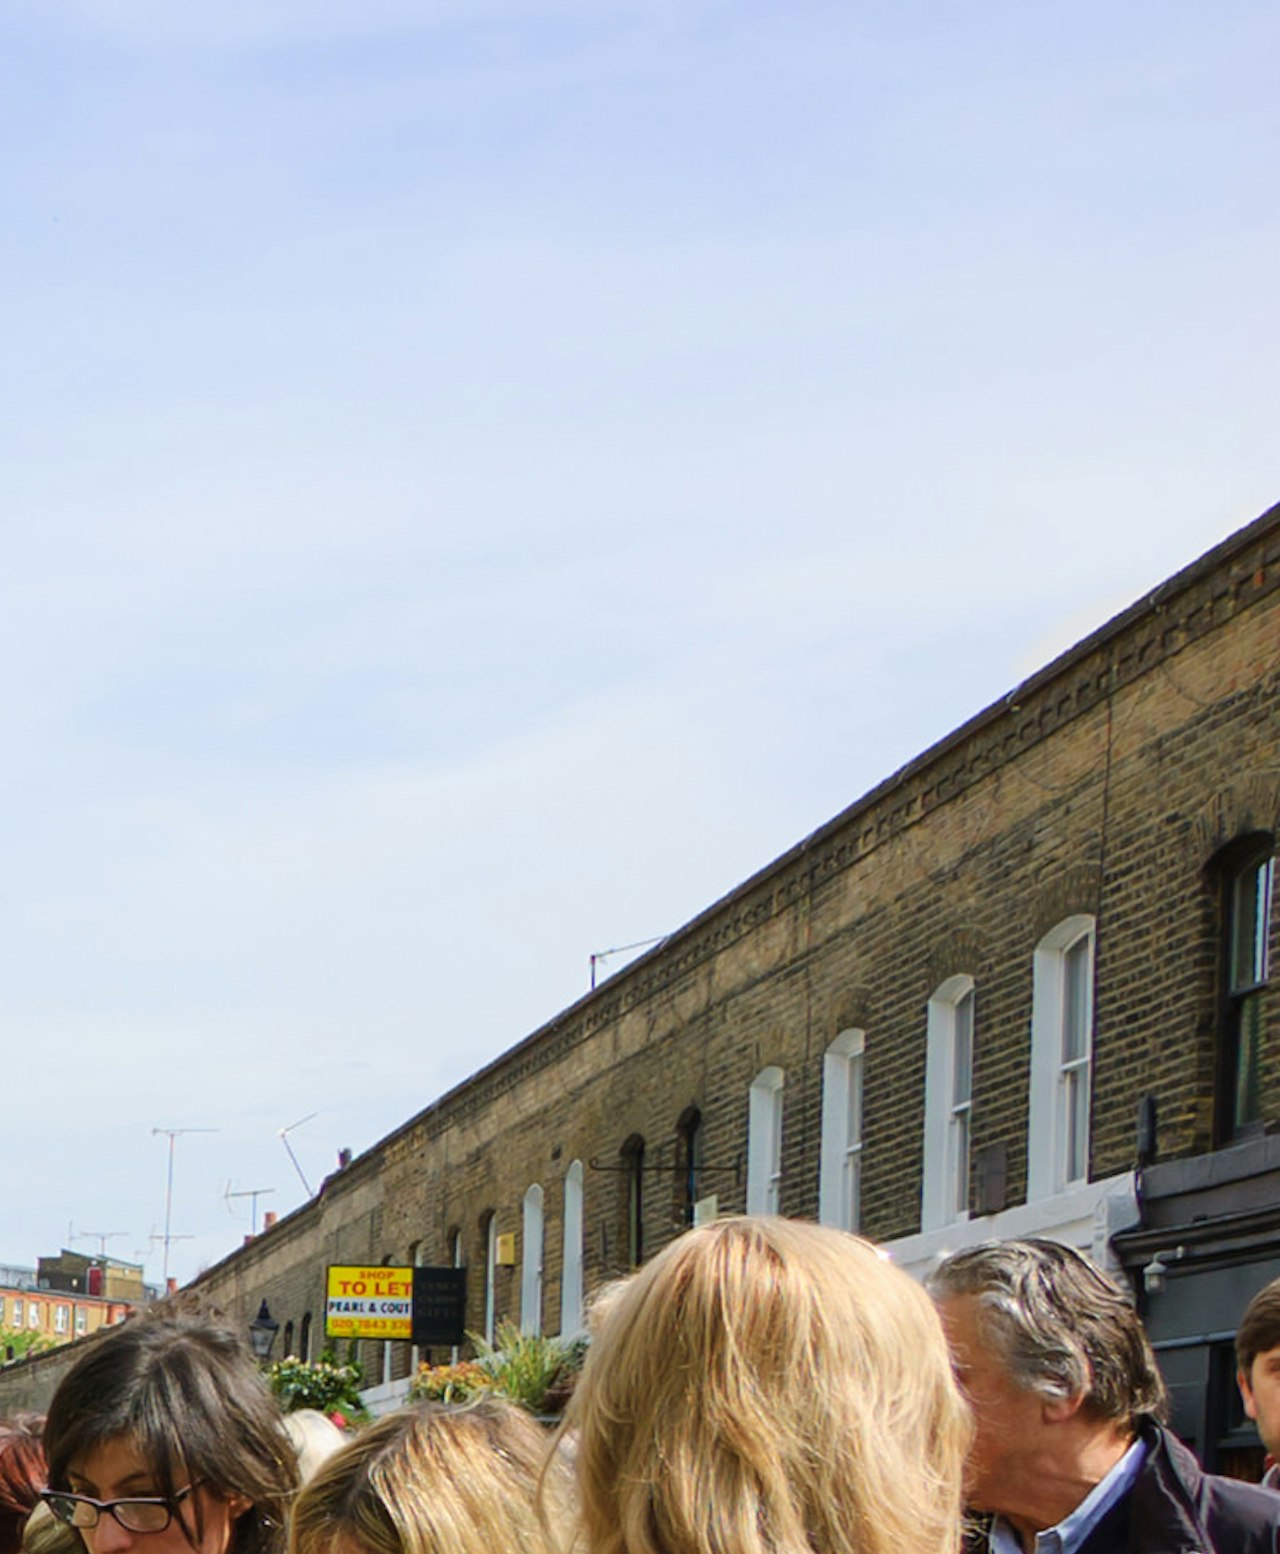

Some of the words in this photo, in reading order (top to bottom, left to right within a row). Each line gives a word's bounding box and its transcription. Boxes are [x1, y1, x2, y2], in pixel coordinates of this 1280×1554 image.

[359, 1270, 395, 1280] SHOP
[339, 1281, 367, 1296] TO
[375, 1281, 411, 1297] LET
[328, 1301, 365, 1313] PEARL
[368, 1302, 378, 1313] &
